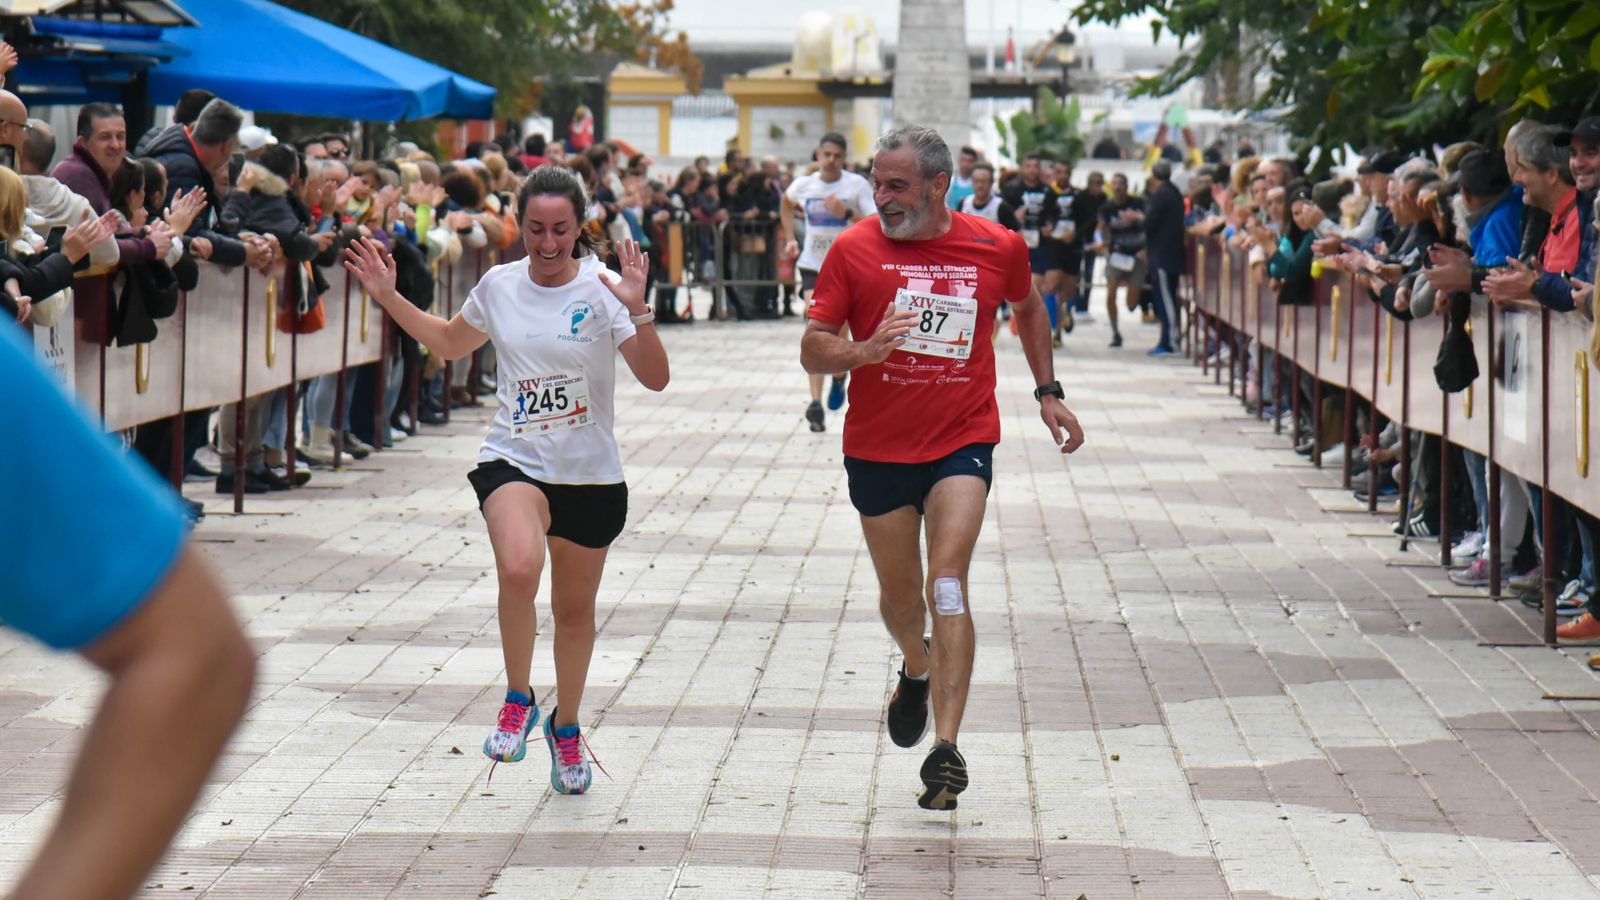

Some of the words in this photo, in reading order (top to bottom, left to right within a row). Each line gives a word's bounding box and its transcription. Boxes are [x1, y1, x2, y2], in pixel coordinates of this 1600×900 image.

[896, 264, 929, 272] CARRERA
[943, 265, 978, 273] ESTRECHO
[900, 270, 932, 279] MEMORIAL
[909, 295, 936, 309] XIV
[936, 299, 961, 308] CARRERA
[947, 306, 974, 315] ESTRECHO
[919, 309, 949, 335] 87
[557, 334, 593, 343] PODÓLOGA
[541, 374, 568, 382] CARRERA
[542, 381, 554, 389] DEL
[554, 376, 583, 387] ESTRECHO
[517, 377, 541, 392] XIV
[526, 386, 568, 415] 245
